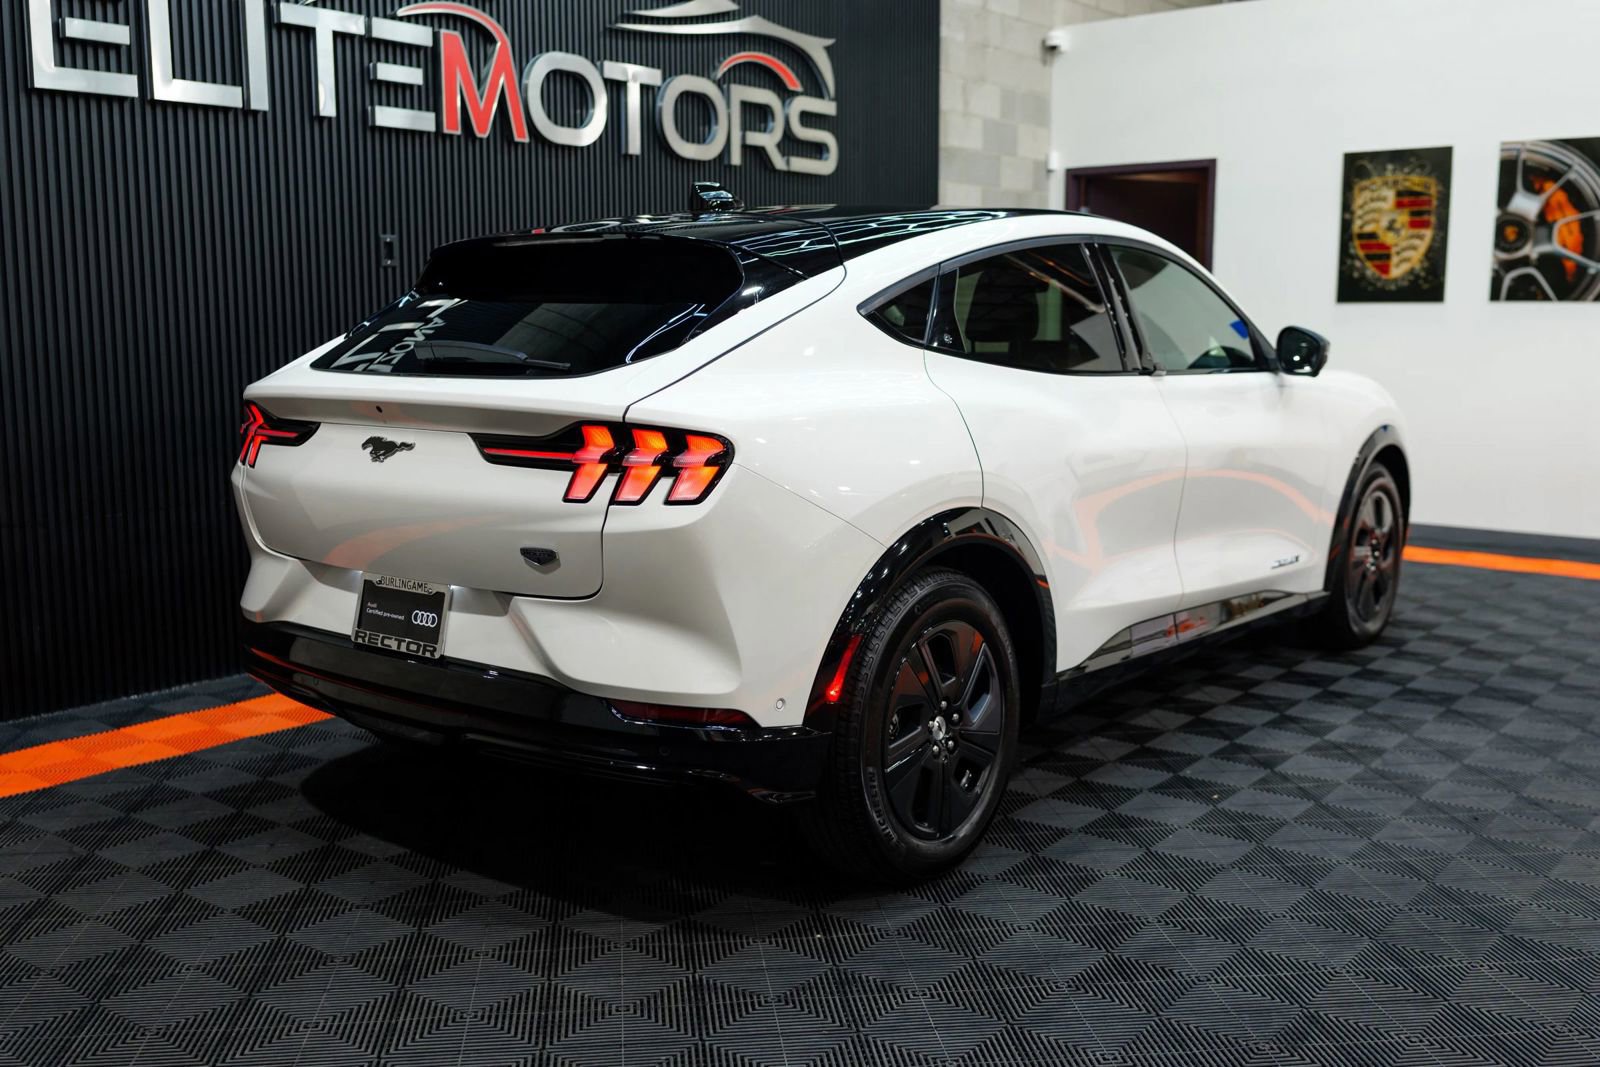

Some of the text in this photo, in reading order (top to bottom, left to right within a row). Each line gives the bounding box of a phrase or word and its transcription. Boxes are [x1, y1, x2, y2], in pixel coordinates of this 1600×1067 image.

[380, 575, 429, 593] BURLINGAME
[366, 607, 384, 616] Certified
[353, 630, 438, 658] RECTOR
[867, 771, 895, 842] MICHELIN
